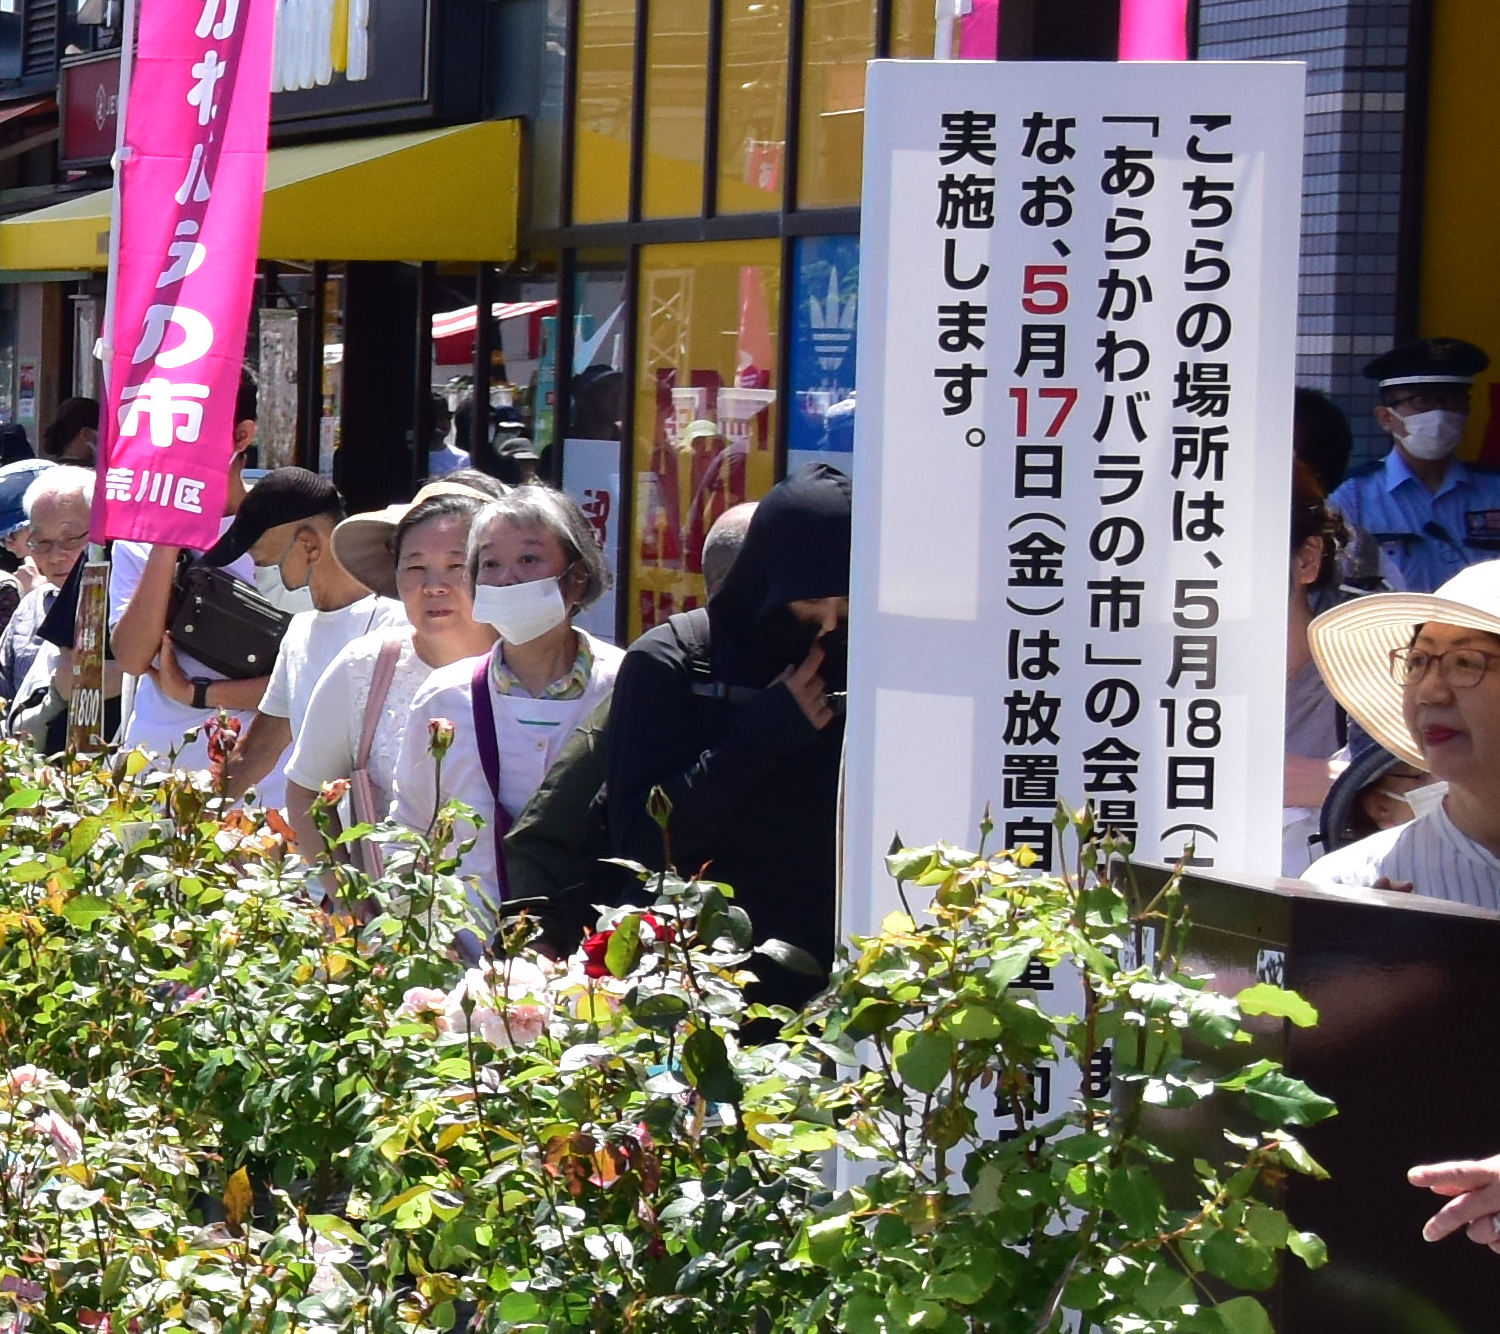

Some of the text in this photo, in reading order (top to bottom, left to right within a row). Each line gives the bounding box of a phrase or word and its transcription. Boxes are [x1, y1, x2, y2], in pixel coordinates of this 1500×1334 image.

[934, 112, 998, 448] 実施します。
[105, 467, 206, 514] 荒川区
